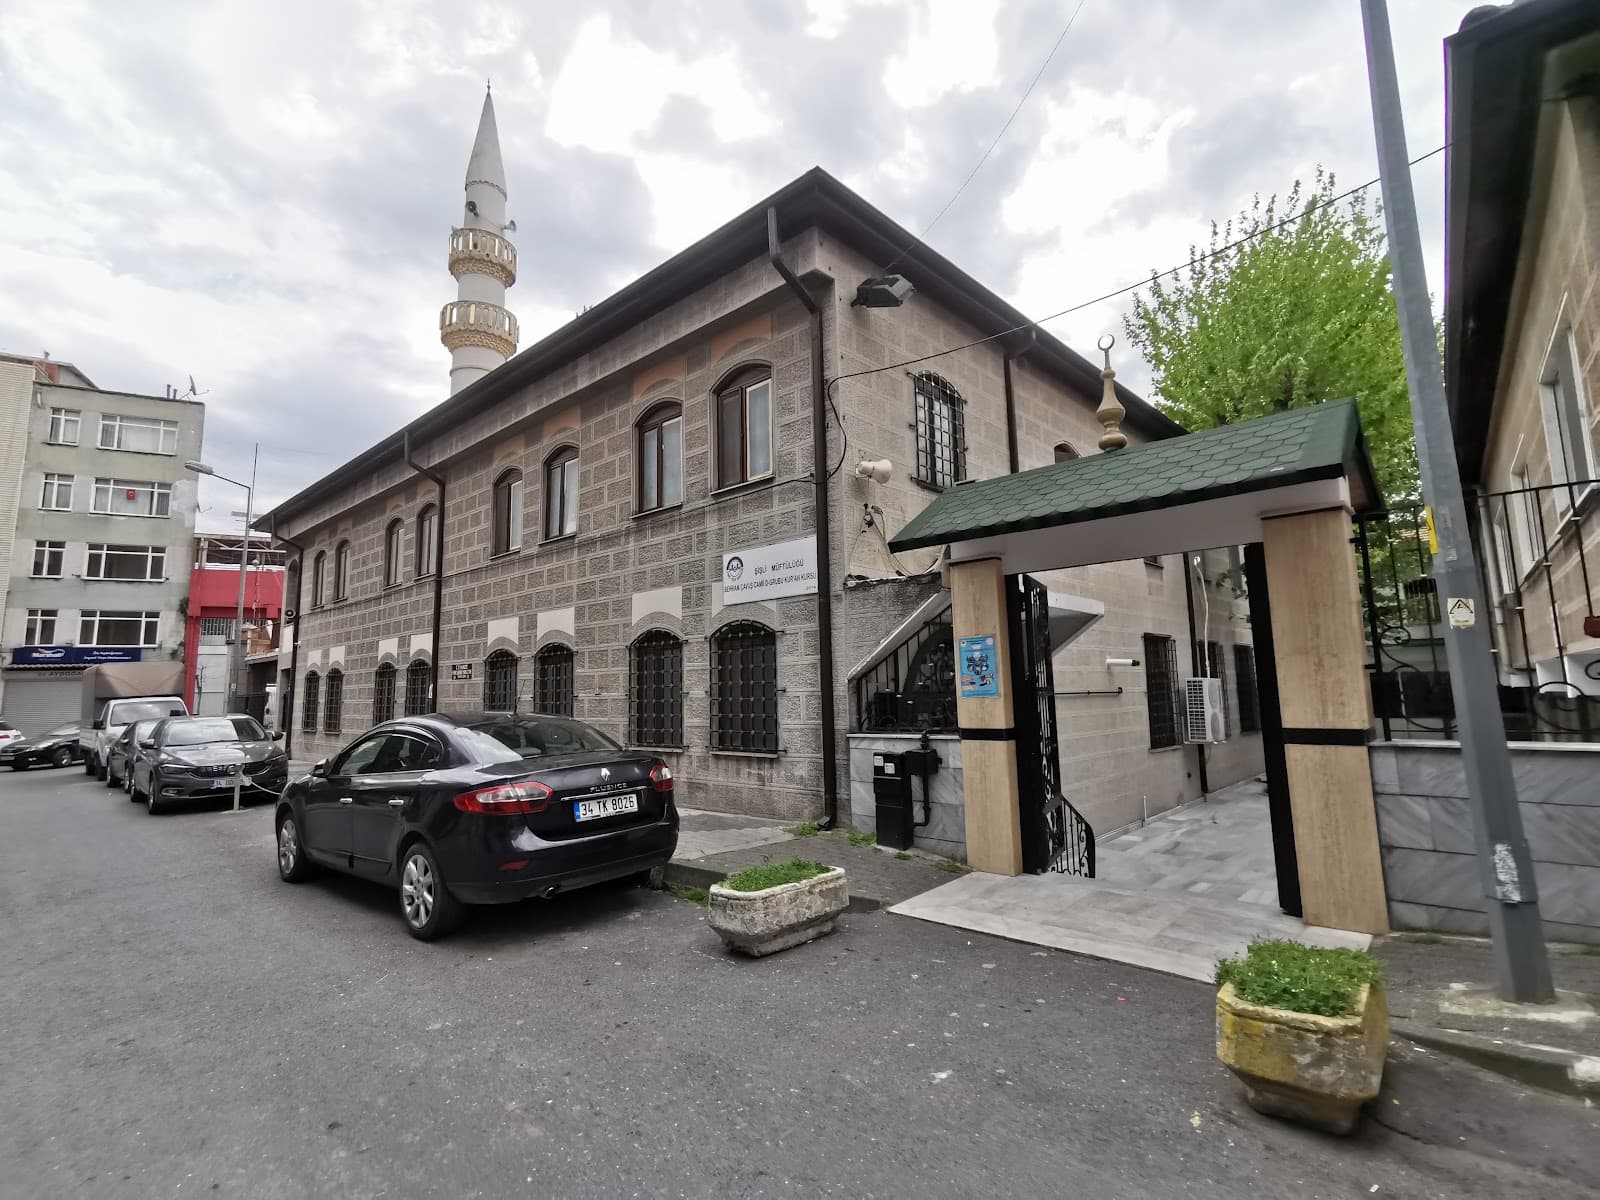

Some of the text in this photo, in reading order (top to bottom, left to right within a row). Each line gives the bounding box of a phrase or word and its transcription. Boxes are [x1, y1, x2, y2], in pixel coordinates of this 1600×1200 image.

[590, 782, 627, 792] FLUENCE
[581, 803, 593, 816] 34
[596, 799, 608, 812] TK
[612, 796, 634, 810] 8026
